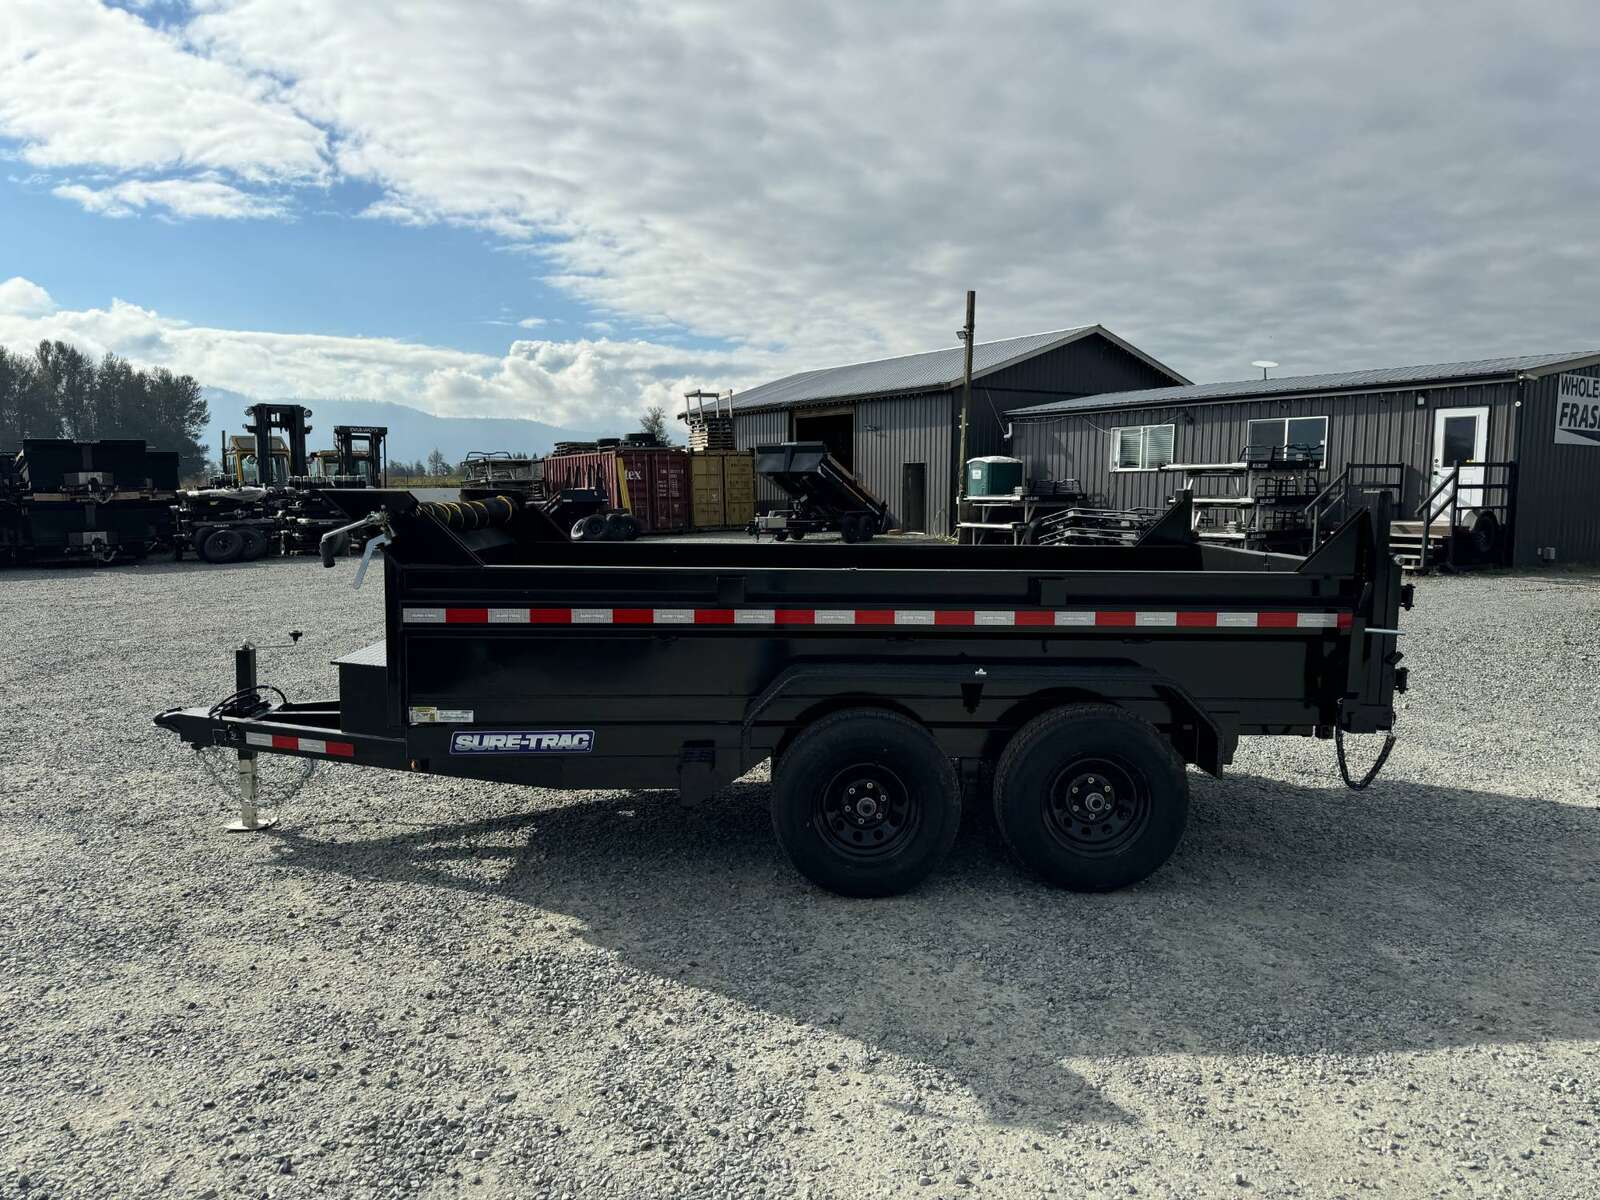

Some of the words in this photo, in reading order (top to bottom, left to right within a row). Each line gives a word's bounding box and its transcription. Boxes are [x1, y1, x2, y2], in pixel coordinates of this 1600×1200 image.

[1561, 376, 1600, 398] WHOLE
[1559, 402, 1600, 429] FRAS
[455, 733, 590, 751] SURE-TRAC
